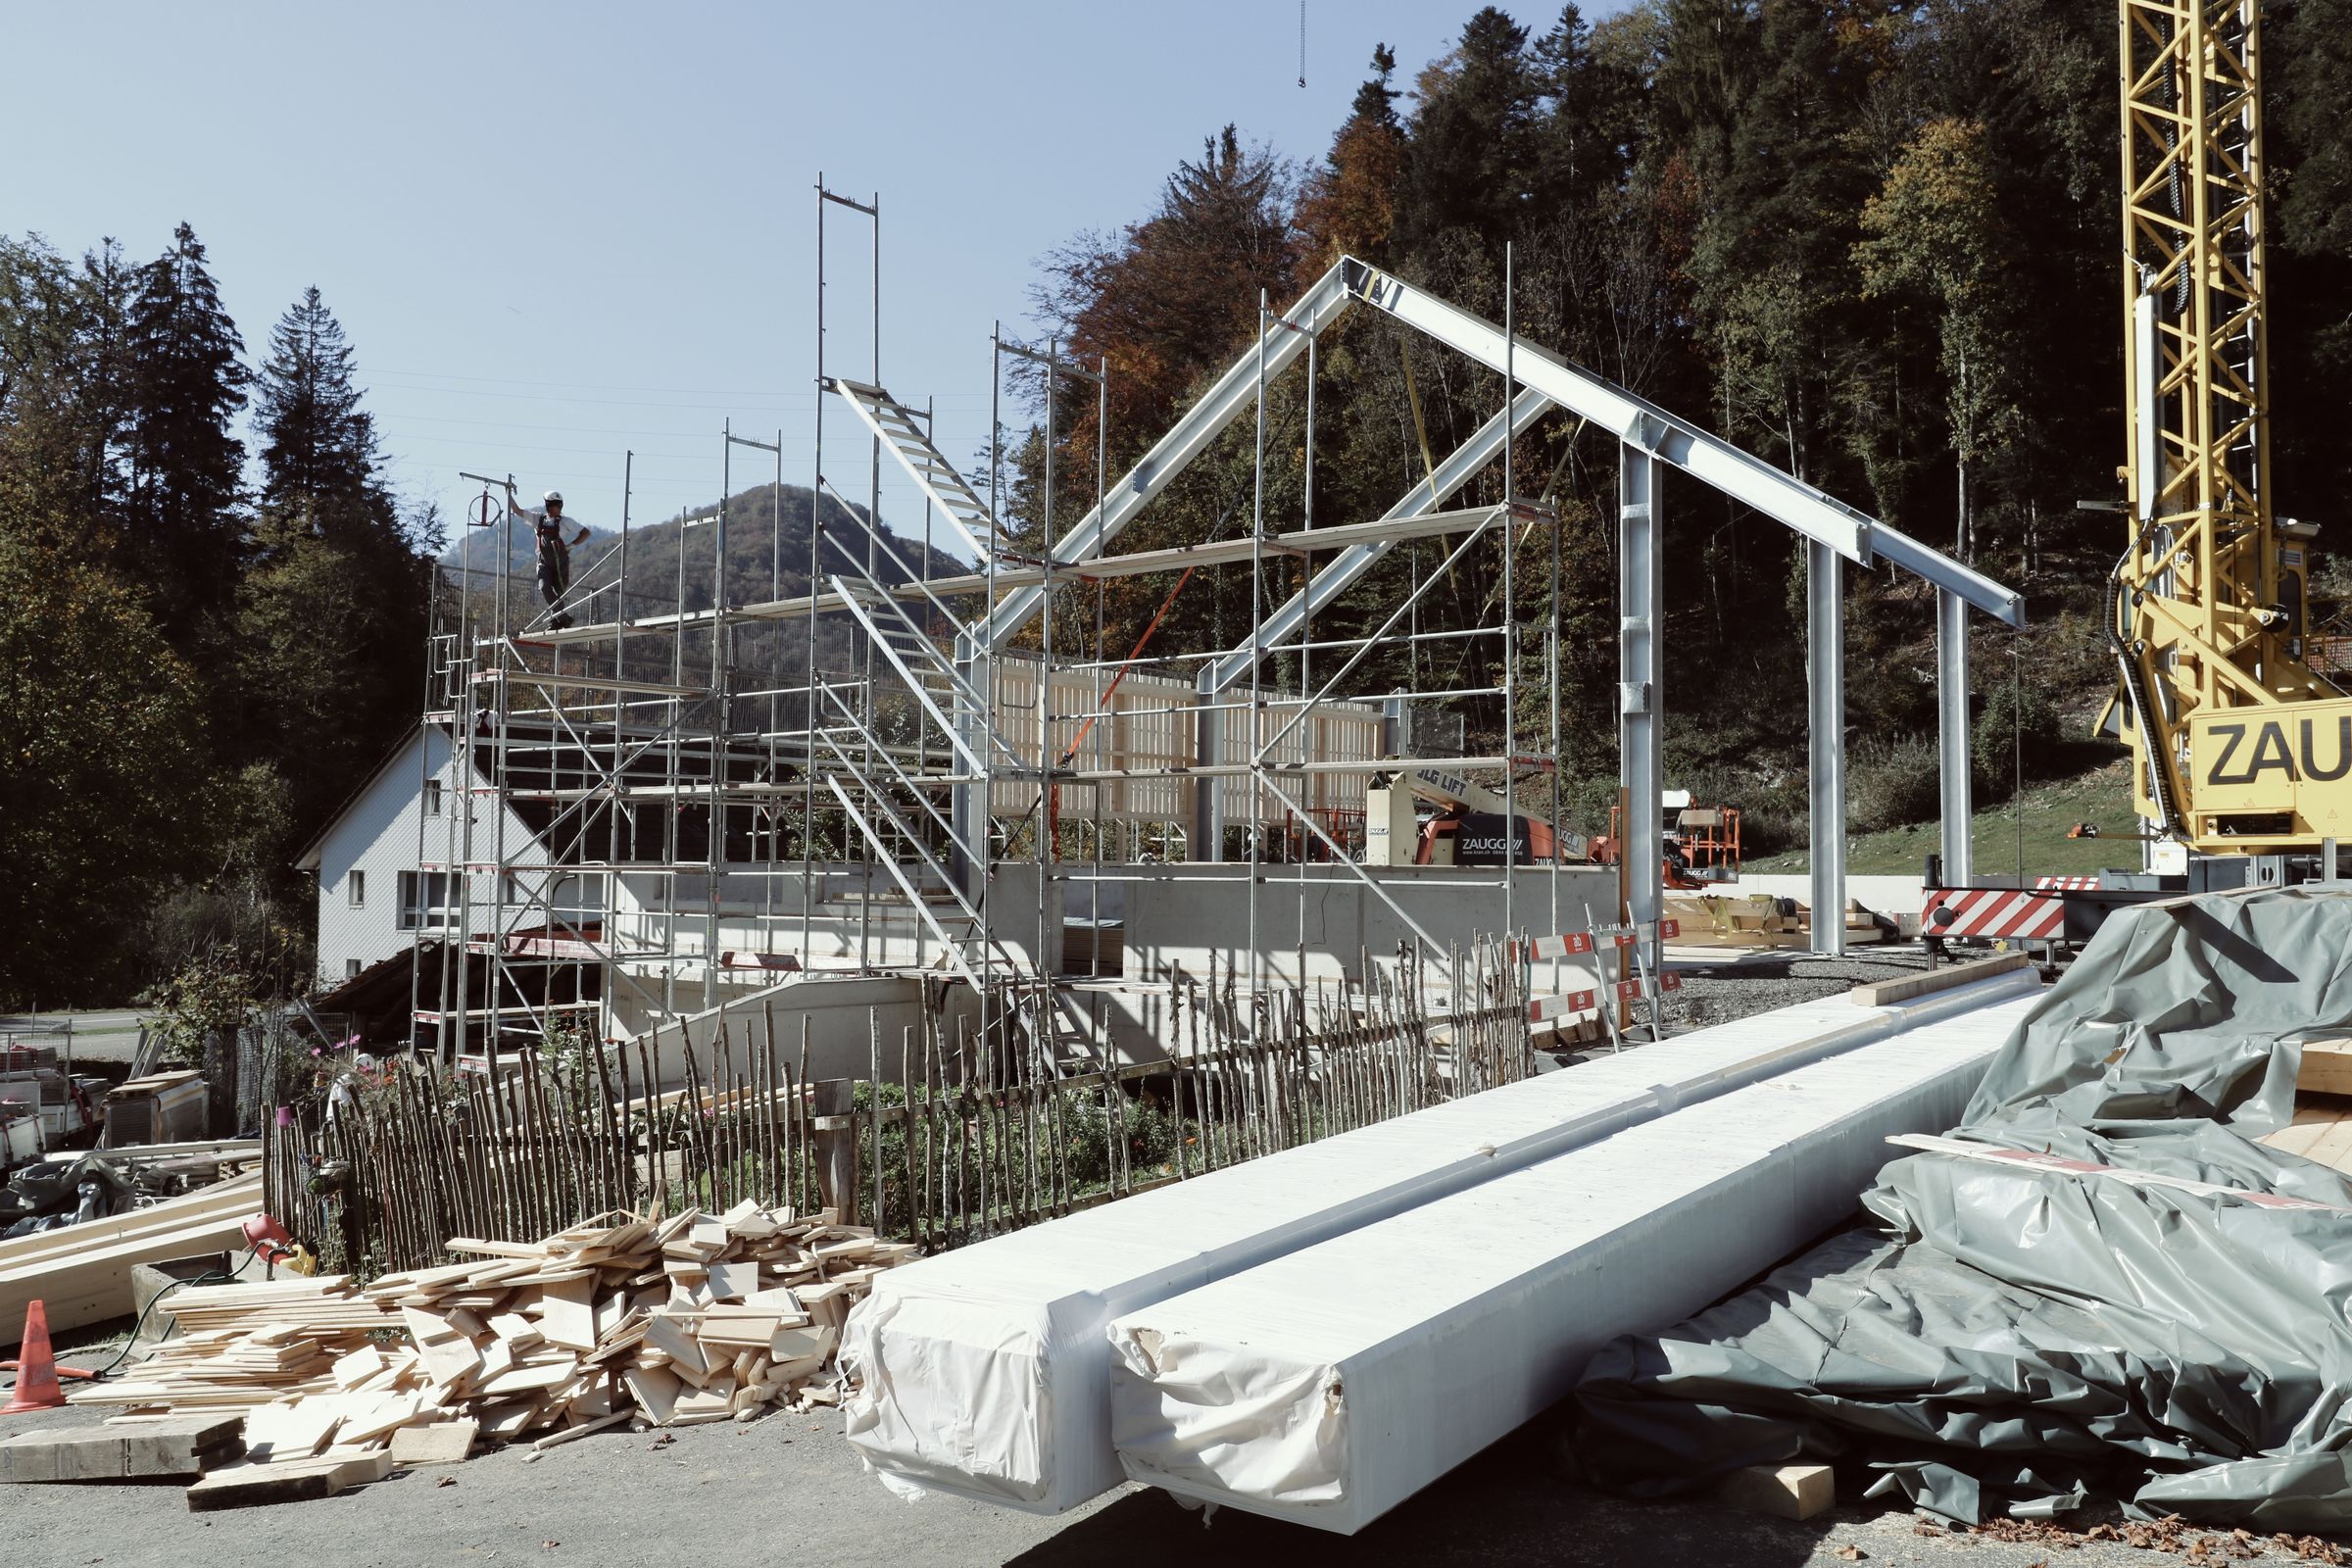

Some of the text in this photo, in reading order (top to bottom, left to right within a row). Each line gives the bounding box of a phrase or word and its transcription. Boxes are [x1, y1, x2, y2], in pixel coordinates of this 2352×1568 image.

[1441, 775, 1466, 797] LIFT
[1462, 838, 1506, 850] ZAUGG
[1558, 827, 1572, 844] UGG
